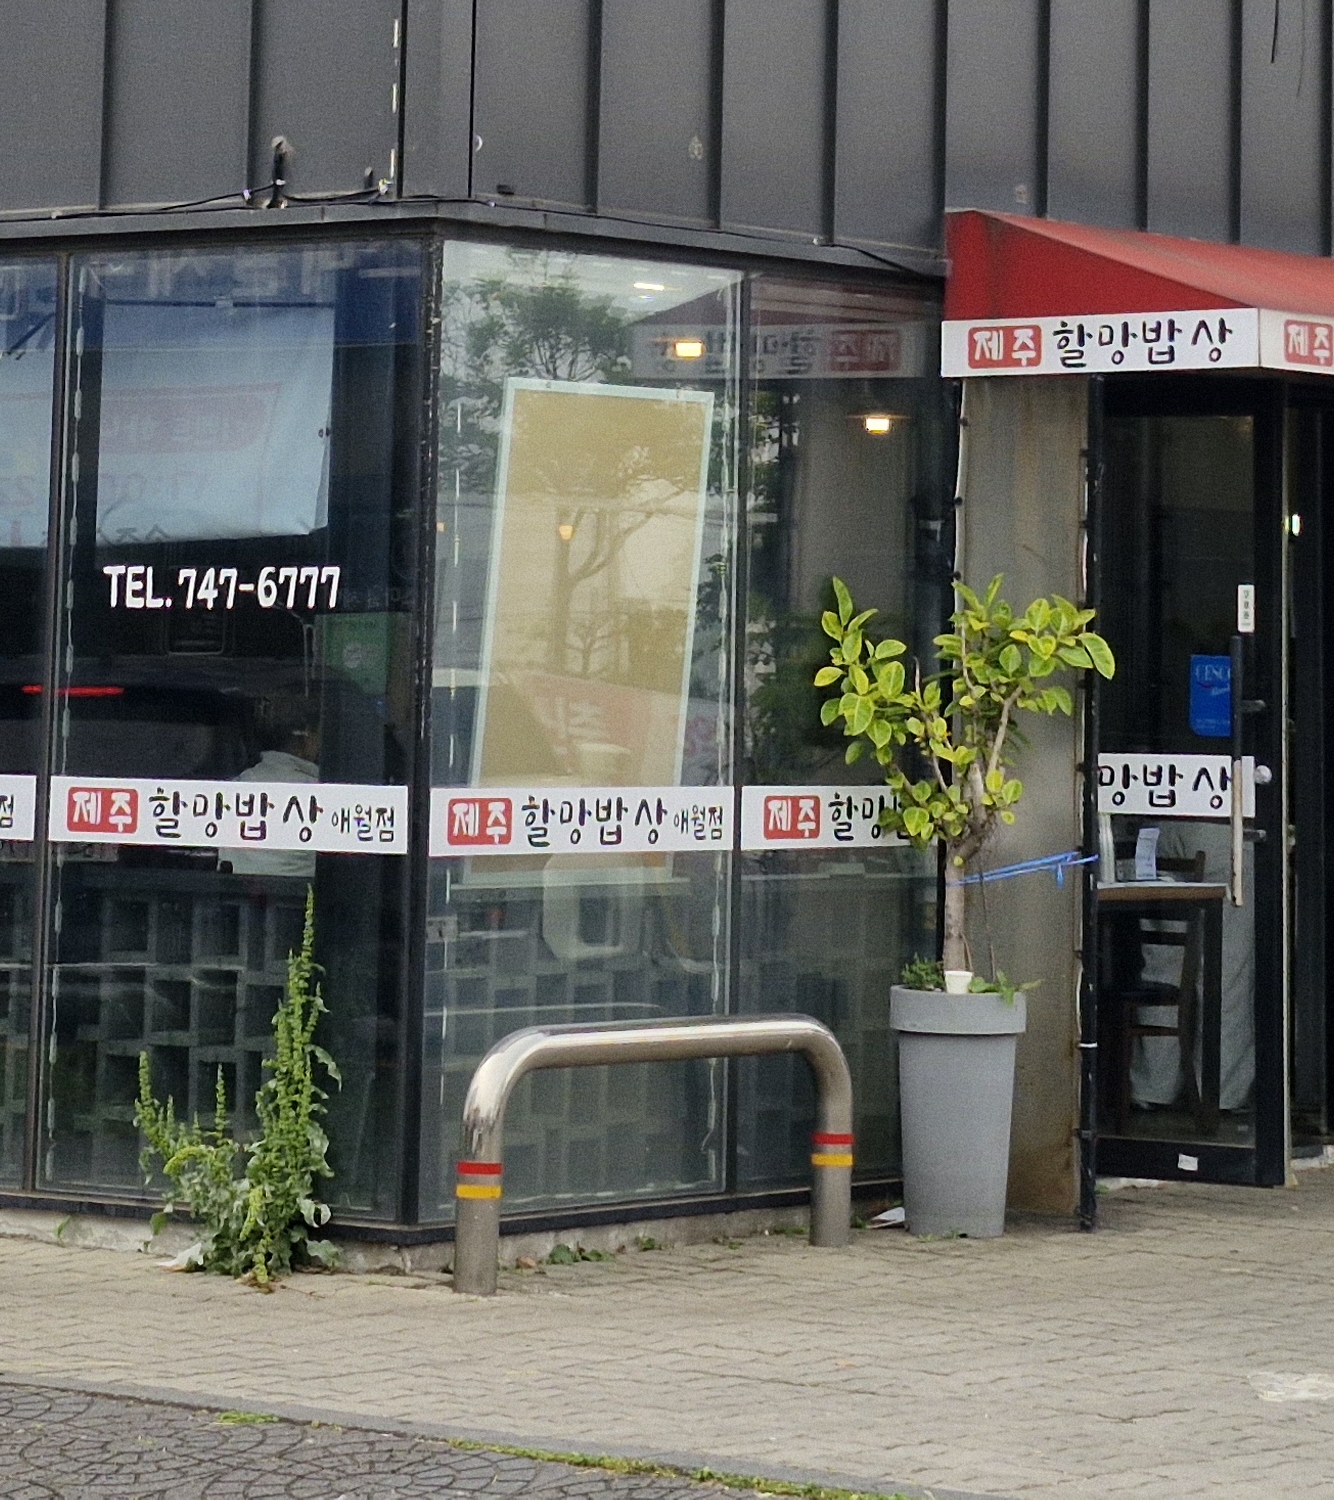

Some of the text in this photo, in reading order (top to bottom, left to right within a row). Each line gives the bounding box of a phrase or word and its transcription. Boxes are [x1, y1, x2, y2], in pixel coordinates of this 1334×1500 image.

[970, 319, 1234, 368] 제주 할망밥상
[1285, 321, 1332, 365] 제주
[103, 564, 342, 609] TEL. 747-6777
[1098, 763, 1232, 810] 망밥상
[71, 787, 395, 842] 제주 할망밥상 애월점
[449, 794, 724, 847] 제주 할망밥상 애월점
[767, 798, 818, 838] 제주
